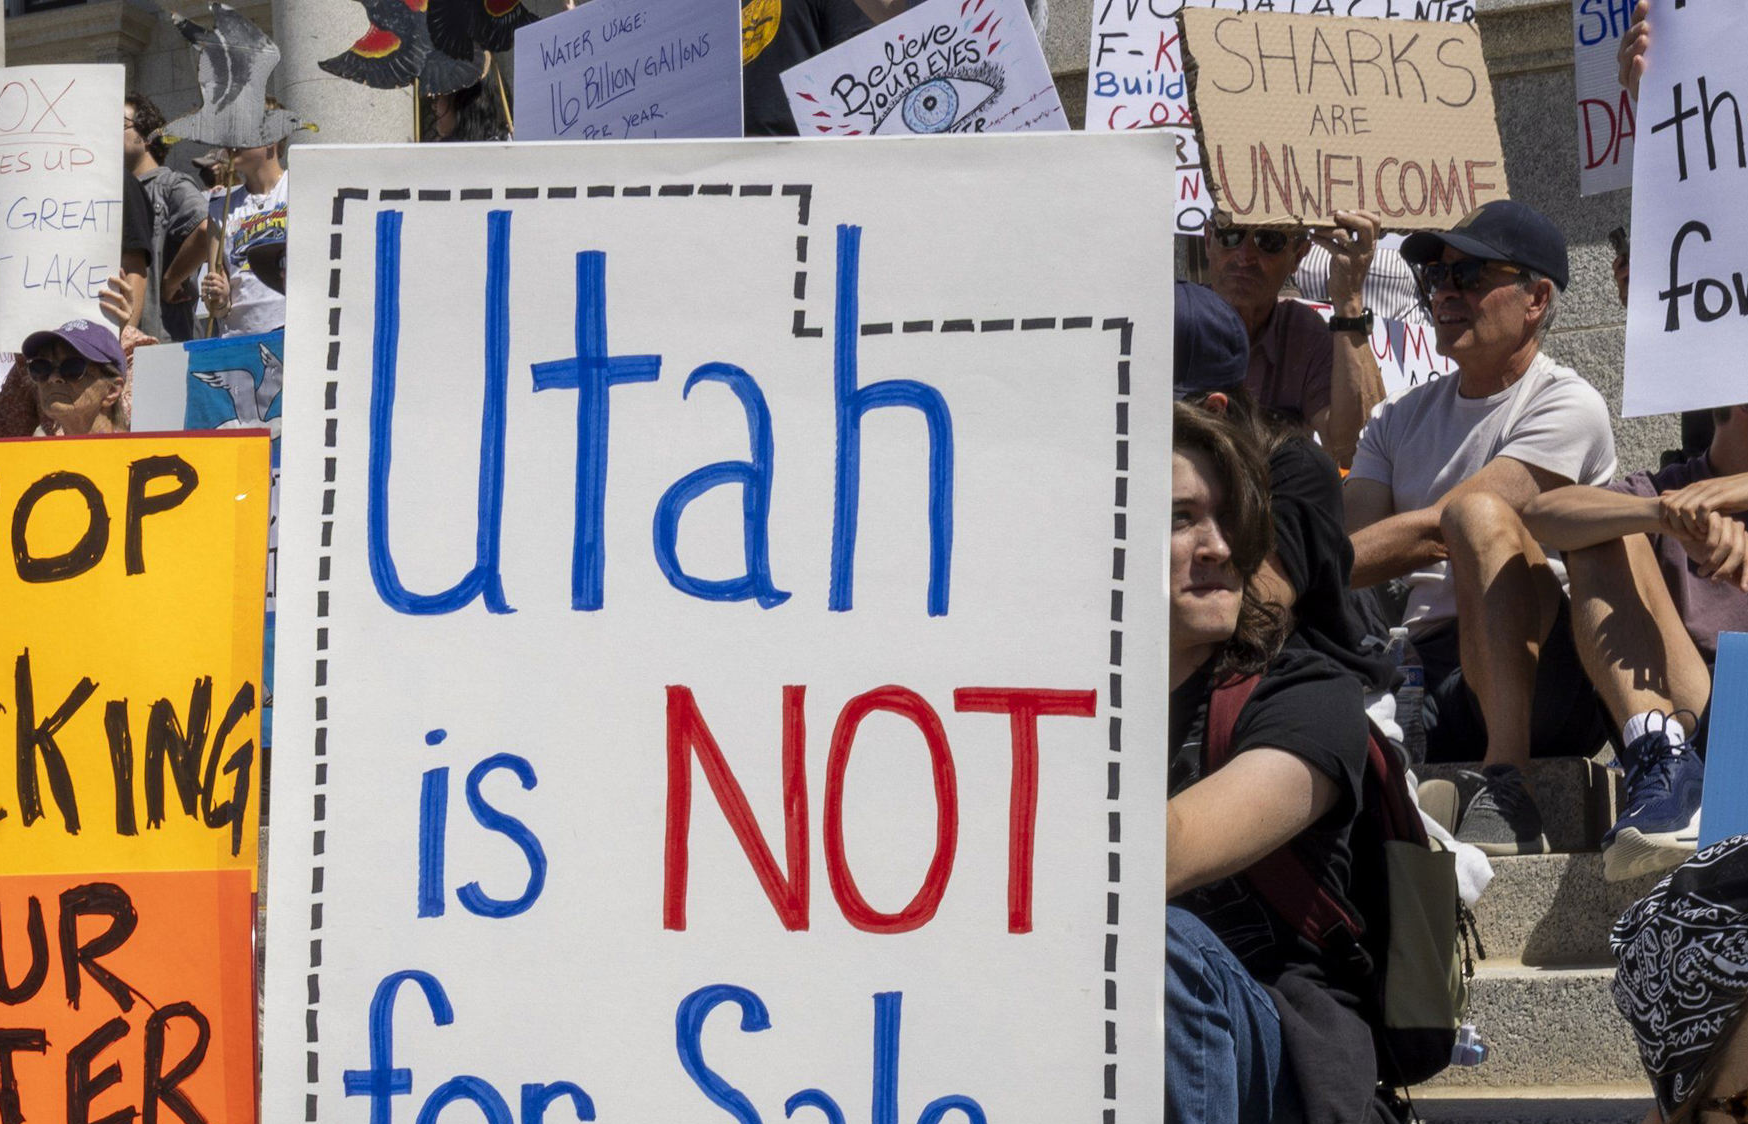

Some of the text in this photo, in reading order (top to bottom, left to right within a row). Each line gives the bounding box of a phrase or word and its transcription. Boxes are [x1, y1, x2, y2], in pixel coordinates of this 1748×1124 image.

[540, 11, 647, 71] WATER USAGE:
[926, 39, 981, 75] EYES
[1211, 17, 1477, 107] SHARKS
[550, 81, 581, 135] 16
[1309, 104, 1372, 136] ARE
[43, 148, 95, 172] UP
[1216, 141, 1498, 219] UNWELCOME
[6, 196, 123, 233] GREAT
[23, 254, 108, 300] LAKE
[367, 209, 955, 617] Utah
[418, 684, 1099, 936] is NOT
